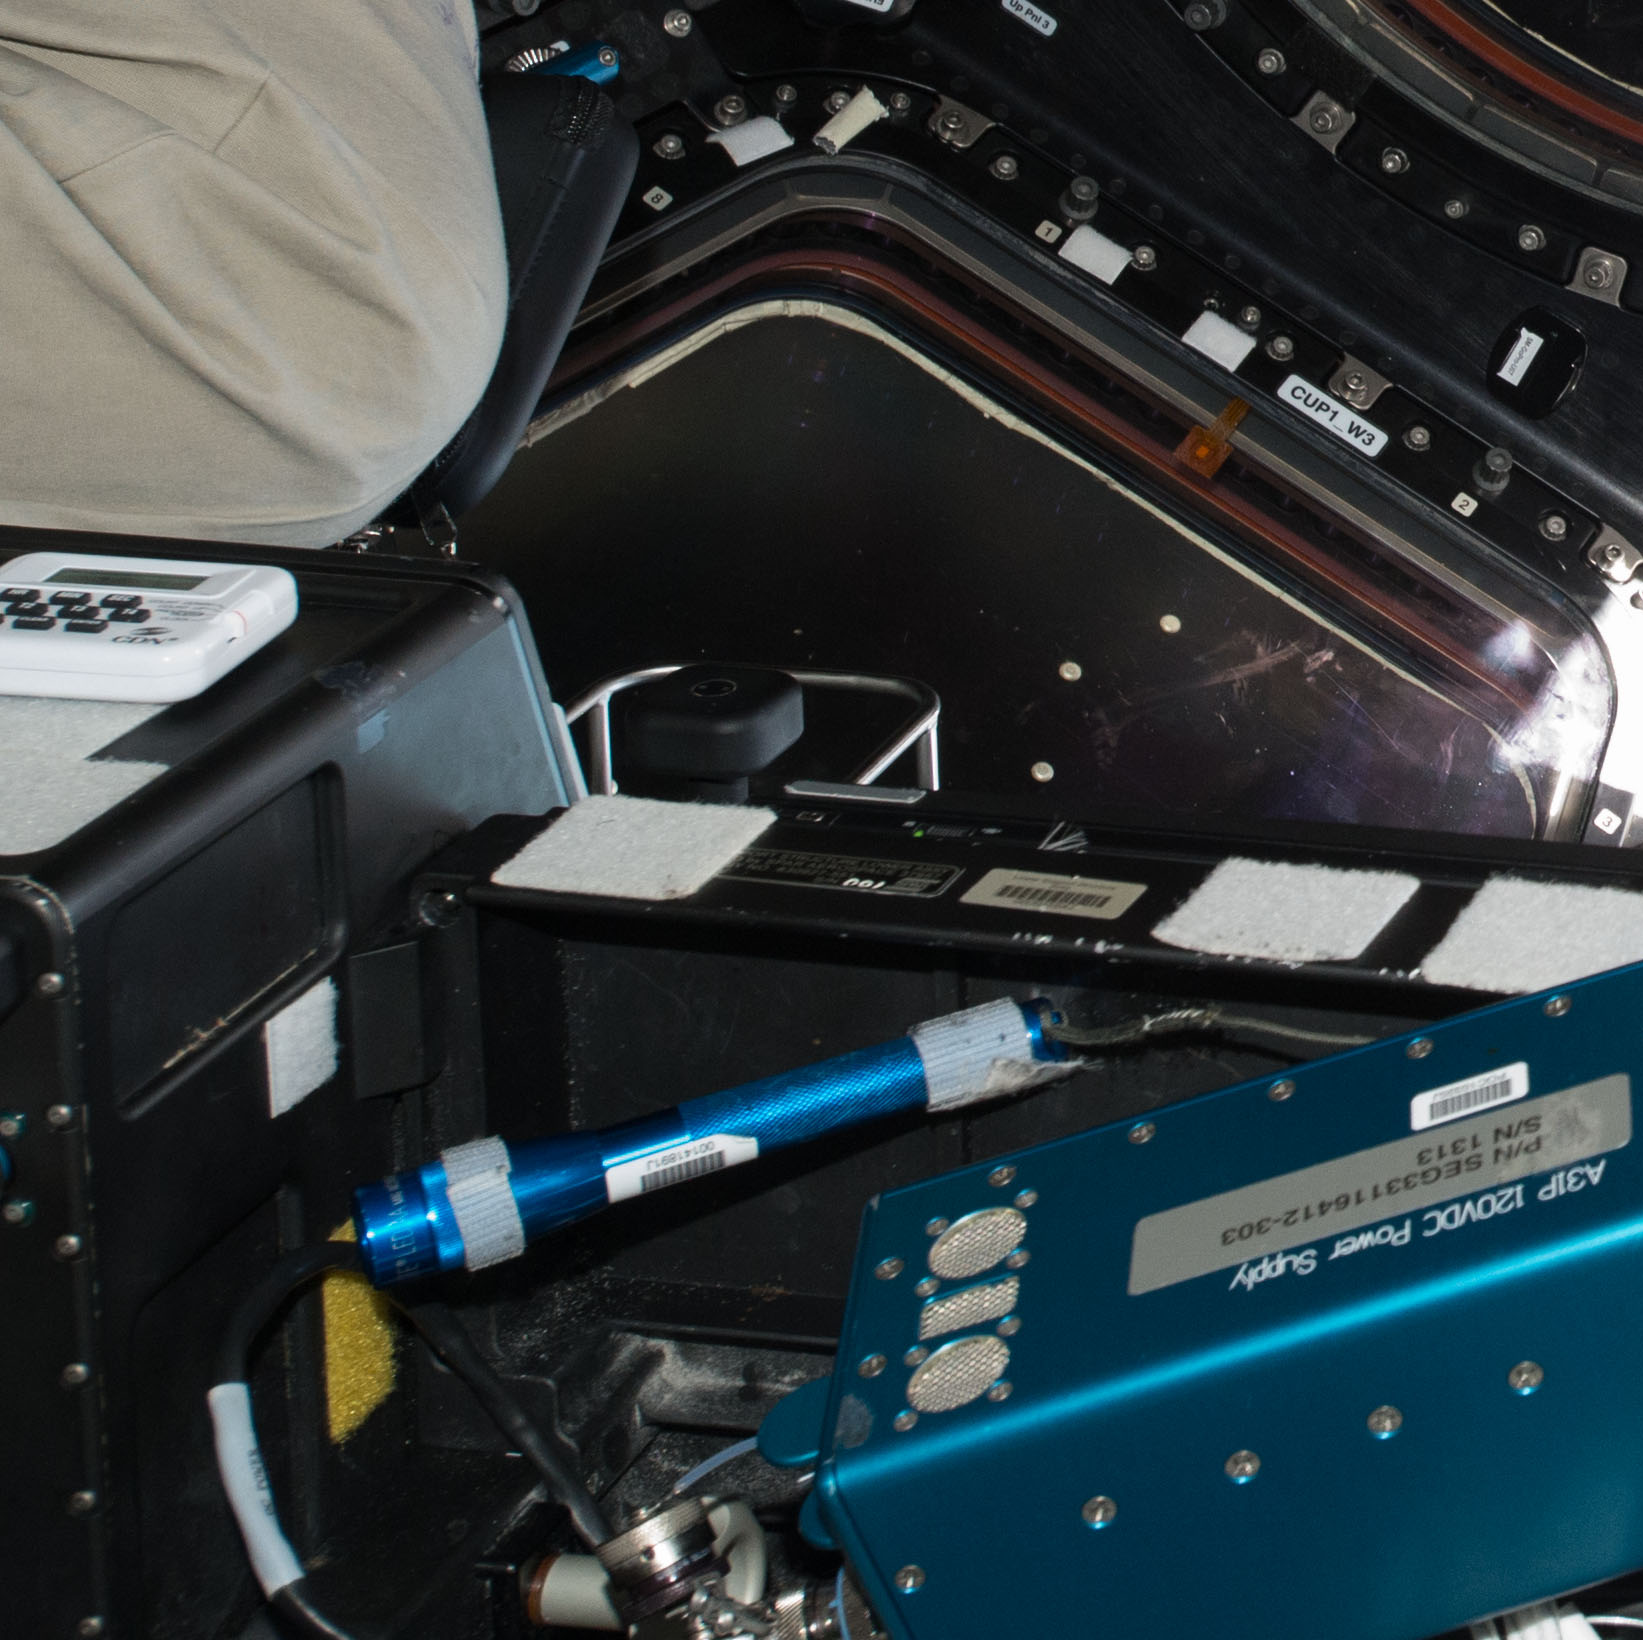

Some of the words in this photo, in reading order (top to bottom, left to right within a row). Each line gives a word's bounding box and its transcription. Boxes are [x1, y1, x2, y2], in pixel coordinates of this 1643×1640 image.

[1025, 6, 1043, 24] Pnl
[1042, 20, 1050, 30] 3
[650, 192, 663, 204] 8
[1043, 226, 1055, 237] 1
[1290, 385, 1376, 447] CUP1_W3
[1458, 499, 1472, 511] 2
[1601, 815, 1614, 828] 3
[1494, 1114, 1542, 1145] S/N
[1416, 1132, 1480, 1167] 1313
[1493, 1134, 1542, 1166] P/N
[1538, 1158, 1605, 1204] A31P
[1220, 1153, 1482, 1248] SEG33116412-303
[1421, 1183, 1525, 1240] 120VDC
[1327, 1218, 1411, 1263] Power
[1230, 1247, 1317, 1297] Supply
